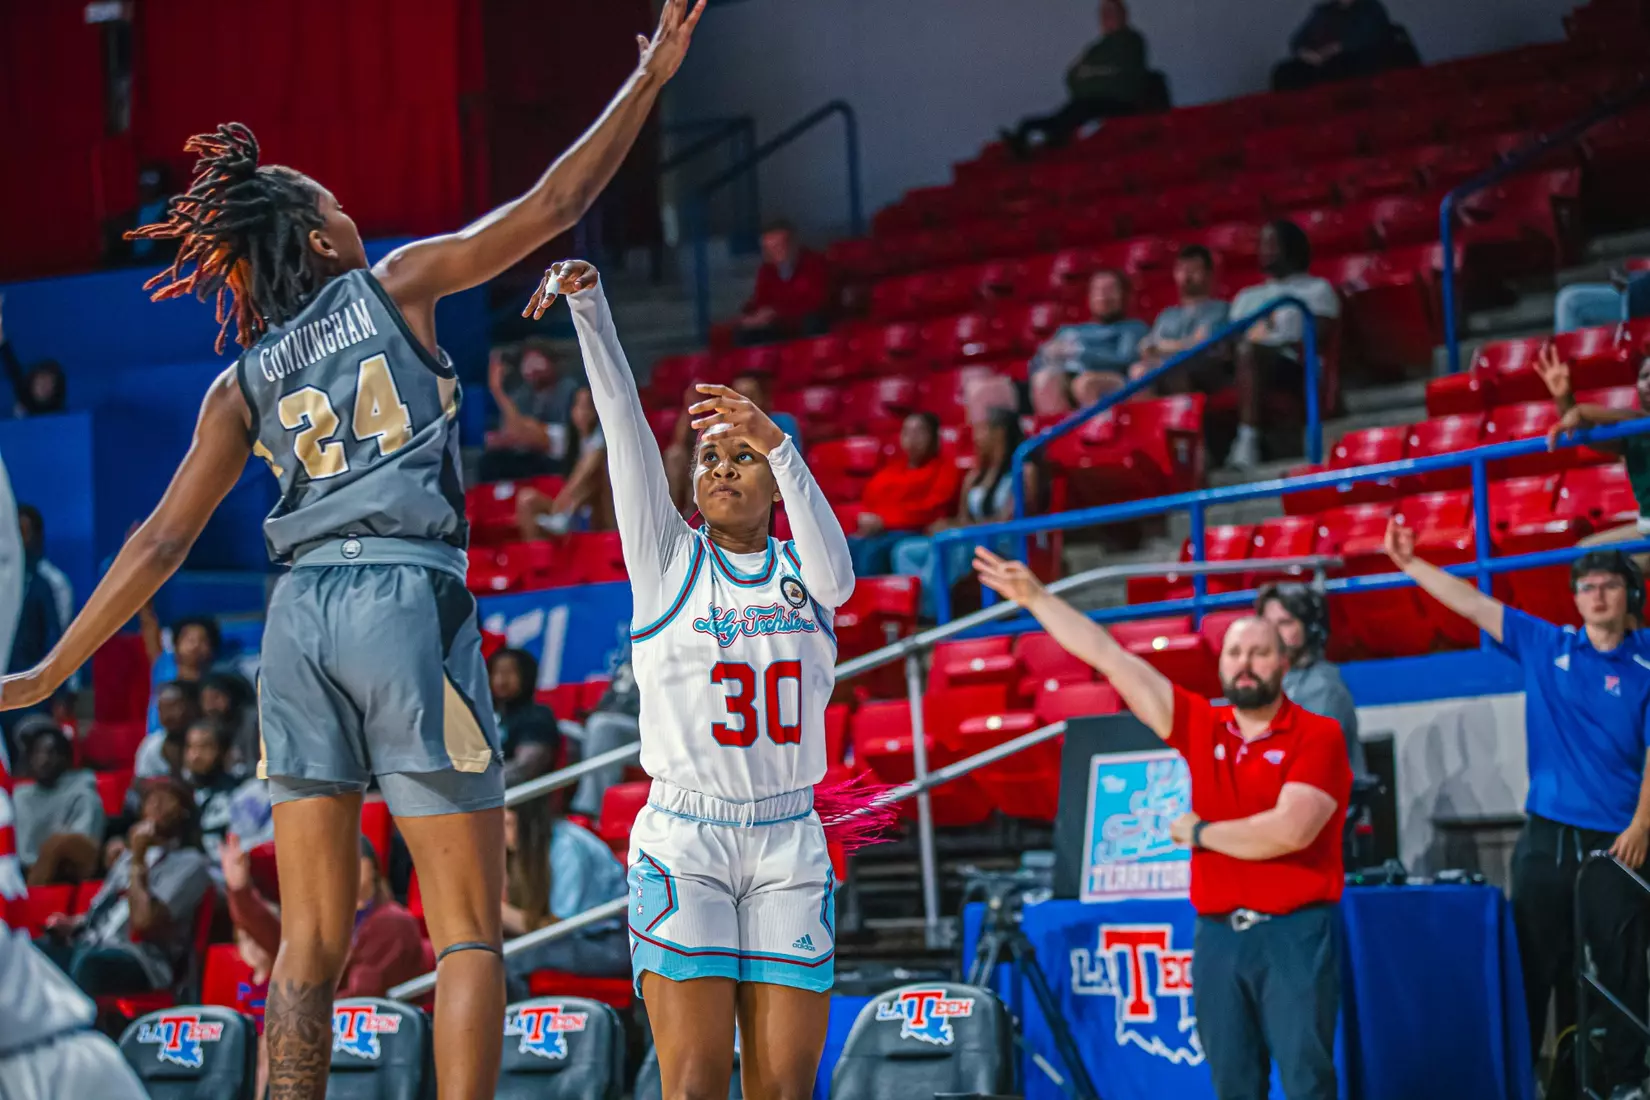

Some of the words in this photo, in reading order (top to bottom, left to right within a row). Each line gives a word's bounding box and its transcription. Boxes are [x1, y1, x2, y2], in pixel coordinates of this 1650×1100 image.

[259, 297, 378, 384] CUNNINGHAM
[278, 351, 414, 480] 24
[710, 659, 803, 748] 30
[792, 941, 816, 952] adidas
[900, 988, 975, 1029] TECH
